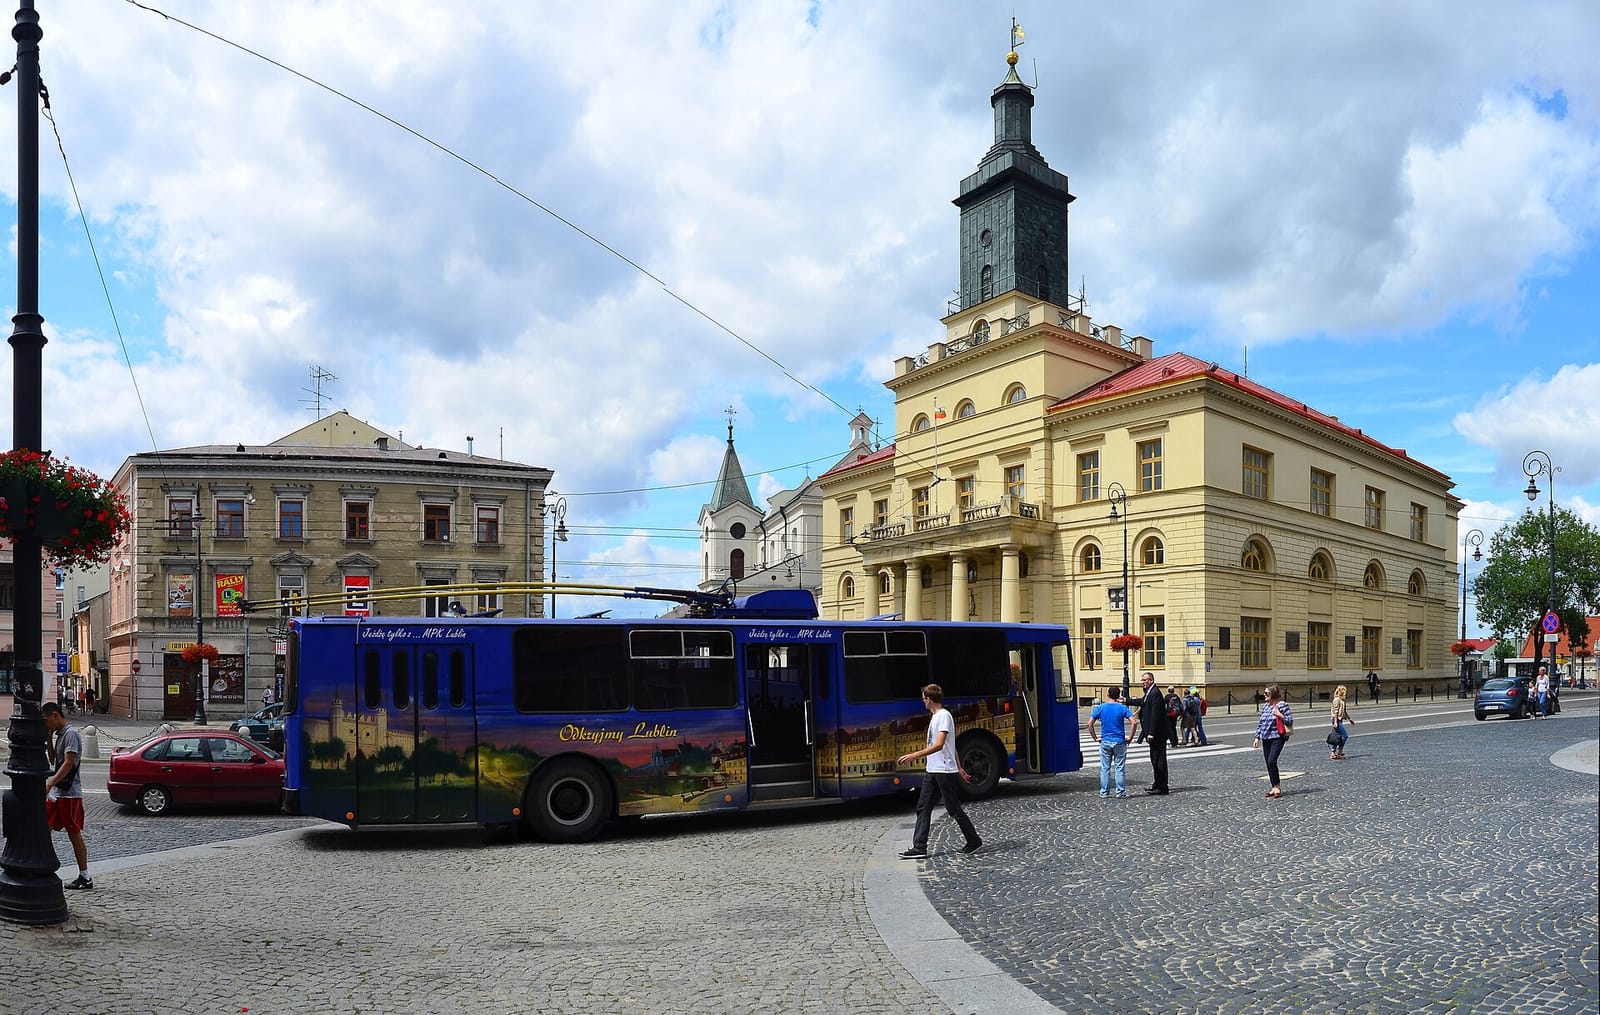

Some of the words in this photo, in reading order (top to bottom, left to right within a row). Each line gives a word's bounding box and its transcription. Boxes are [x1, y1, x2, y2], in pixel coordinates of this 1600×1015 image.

[217, 575, 244, 588] RALLY
[387, 628, 407, 642] tylko
[422, 628, 445, 639] MPK
[445, 628, 467, 638] Lublin
[797, 628, 815, 639] MPK
[815, 629, 832, 638] Lublin
[559, 724, 624, 744] Odkryjmy
[627, 722, 678, 739] Lublin
